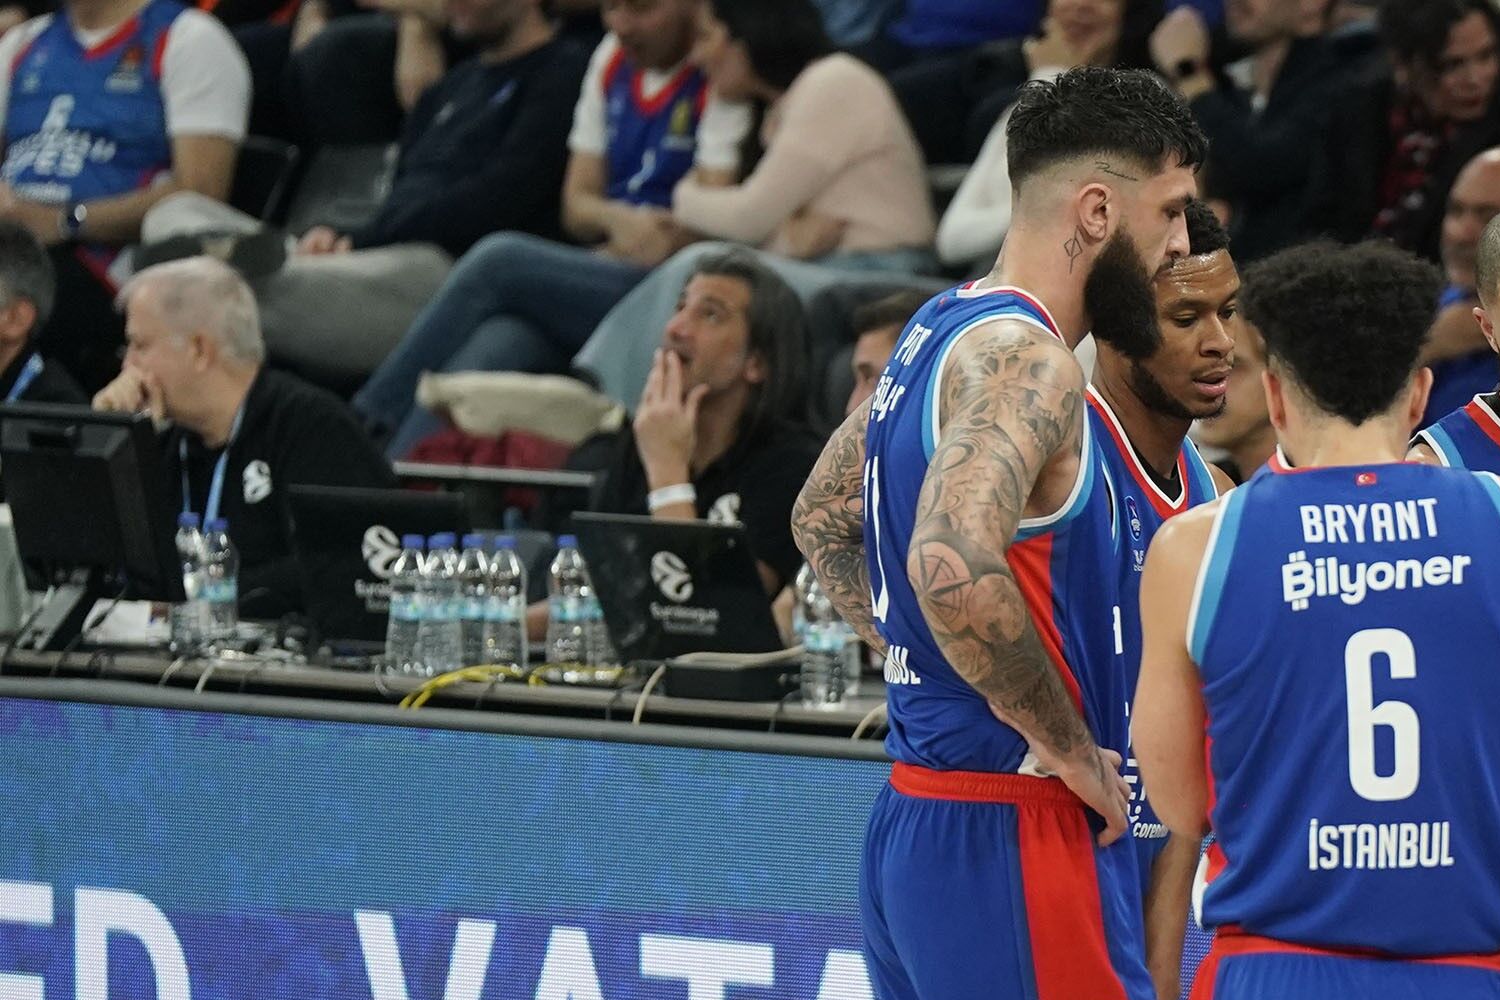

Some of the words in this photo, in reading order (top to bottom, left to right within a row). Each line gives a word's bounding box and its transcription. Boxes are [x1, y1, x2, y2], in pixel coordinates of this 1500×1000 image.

[1300, 498, 1438, 544] BRYANT
[1282, 550, 1471, 611] Bilyoner
[1344, 627, 1420, 802] 6
[1309, 818, 1454, 870] İSTANBUL
